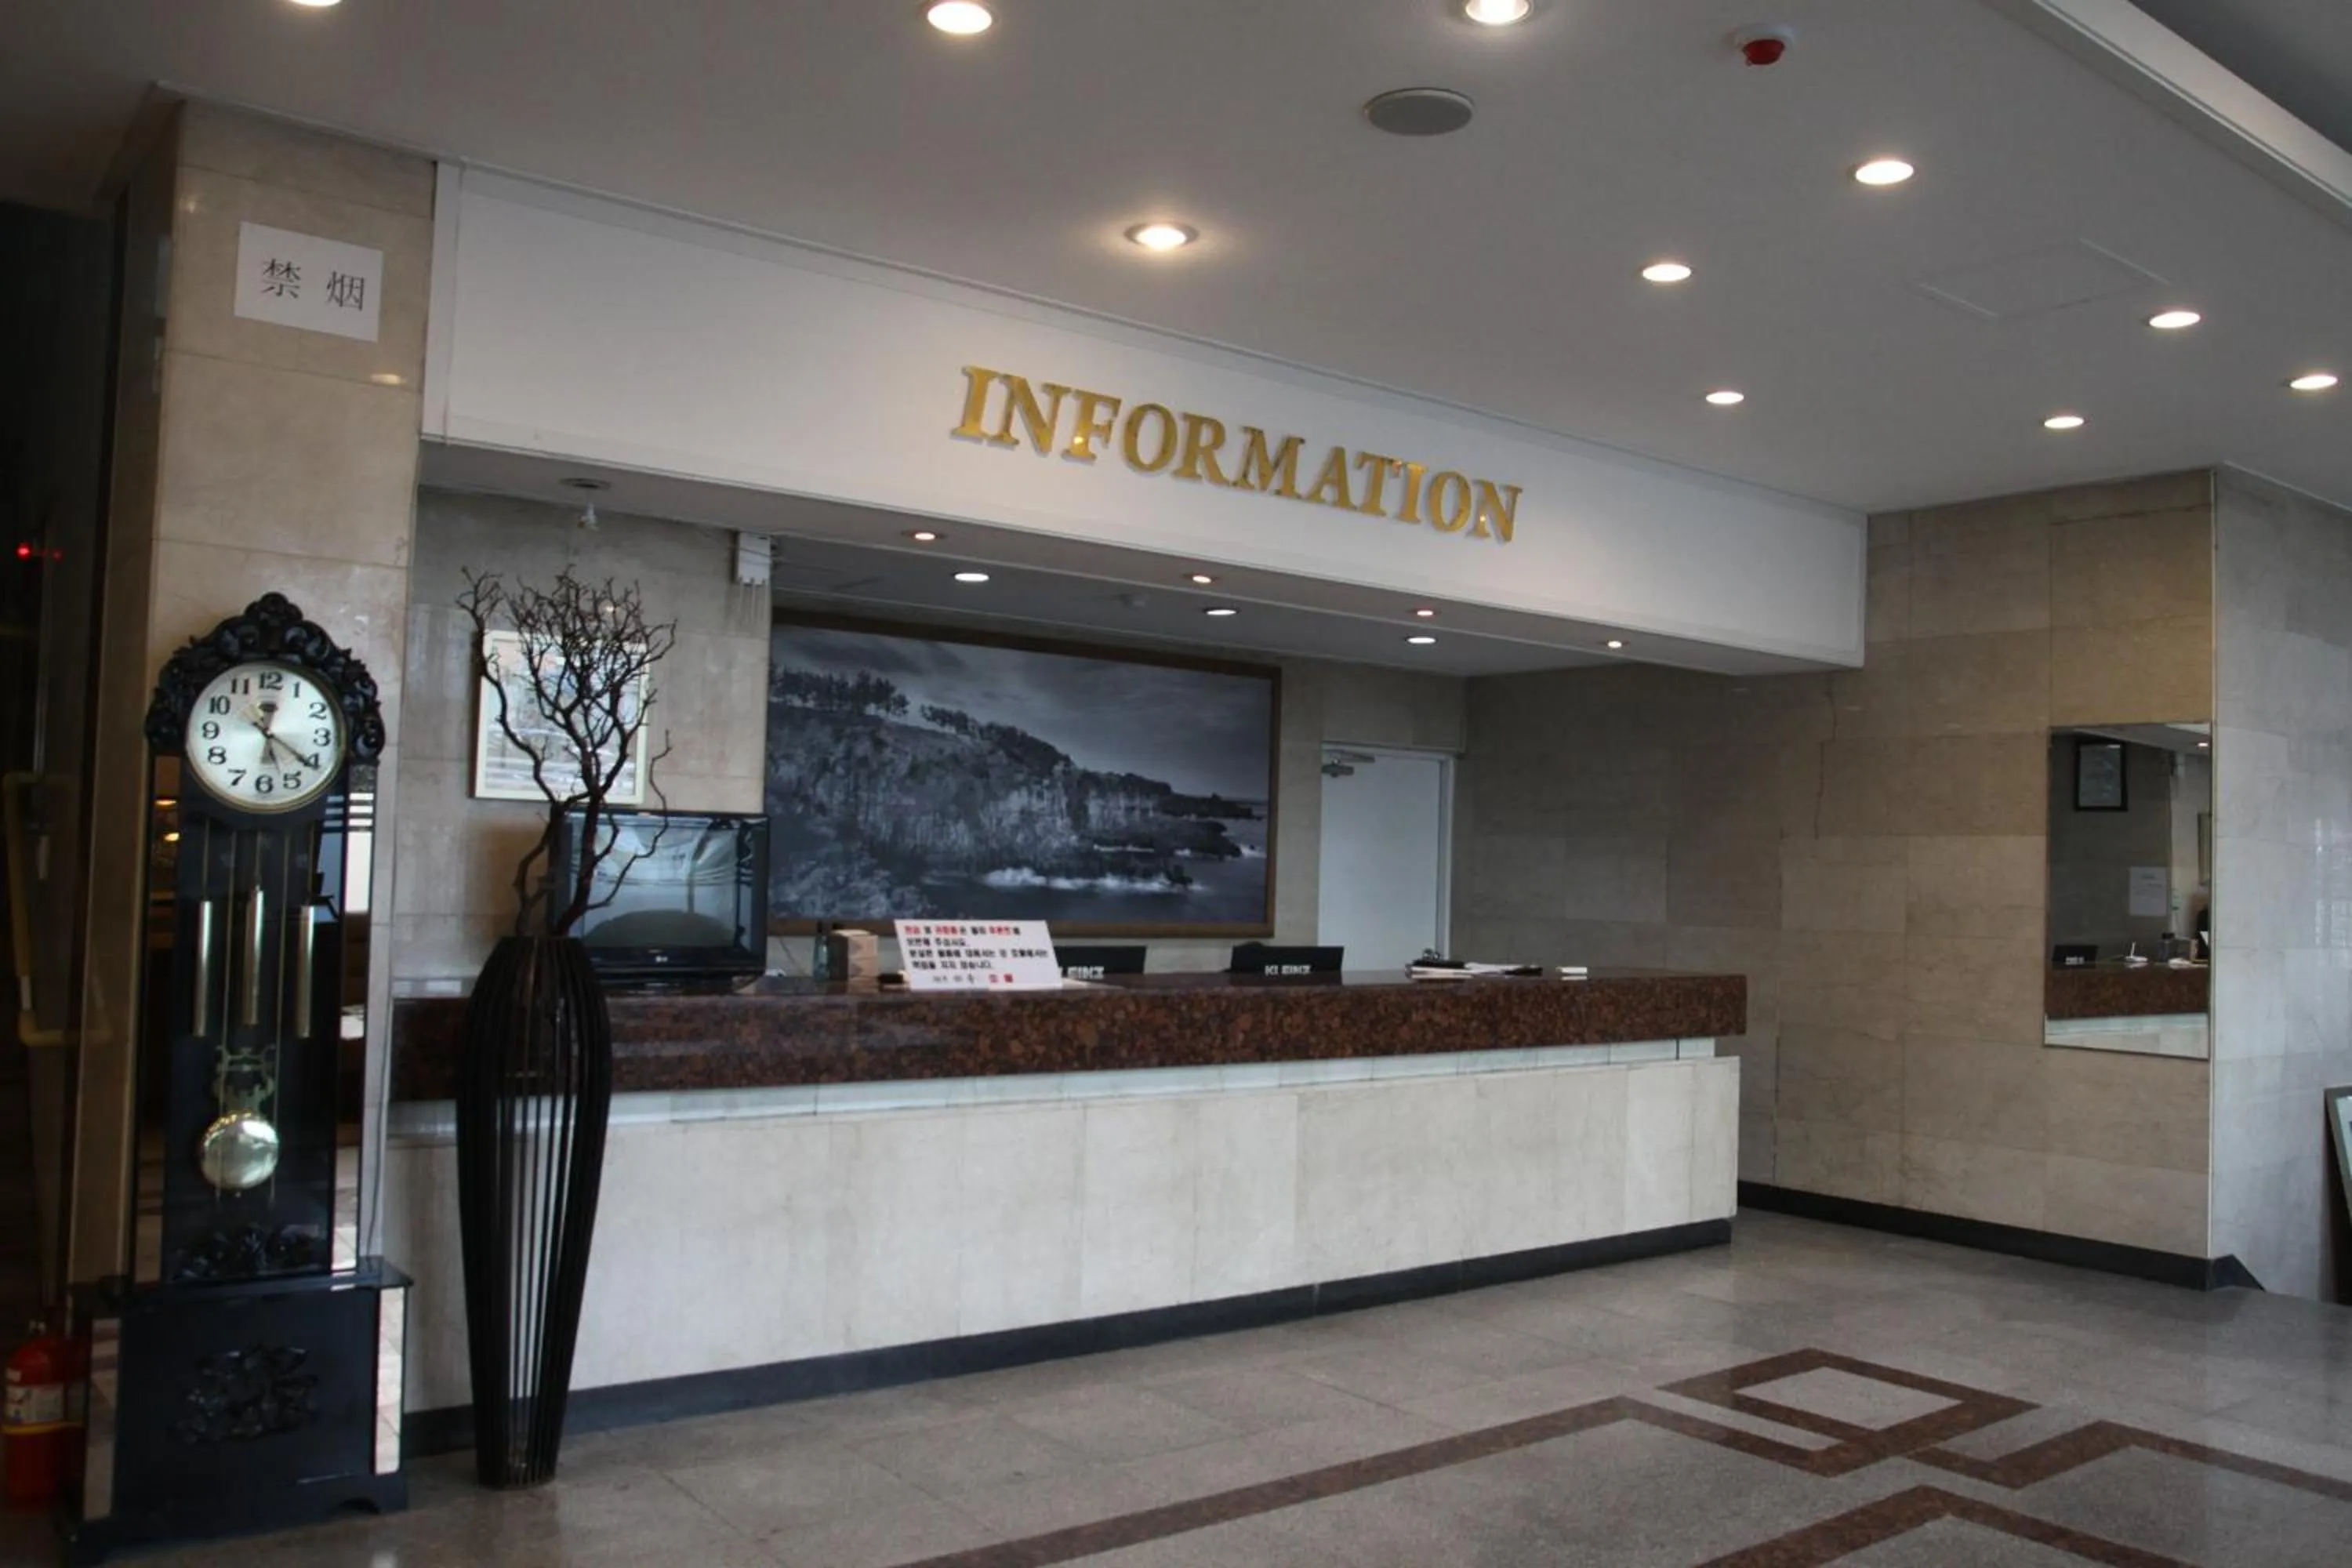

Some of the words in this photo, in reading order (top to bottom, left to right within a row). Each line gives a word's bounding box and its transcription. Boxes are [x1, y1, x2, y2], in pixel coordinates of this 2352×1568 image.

[261, 258, 365, 311] 禁烟
[951, 365, 1523, 543] INFORMATION
[231, 679, 249, 695] 11
[260, 672, 283, 690] 12
[294, 682, 300, 698] 1
[209, 696, 230, 715] 10
[309, 702, 327, 720] 2
[202, 722, 219, 739] 9
[314, 728, 331, 747] 3
[208, 747, 227, 764] 8
[305, 753, 321, 771] 4
[227, 769, 247, 786] 7
[256, 775, 273, 793] 6
[283, 771, 301, 789] 5
